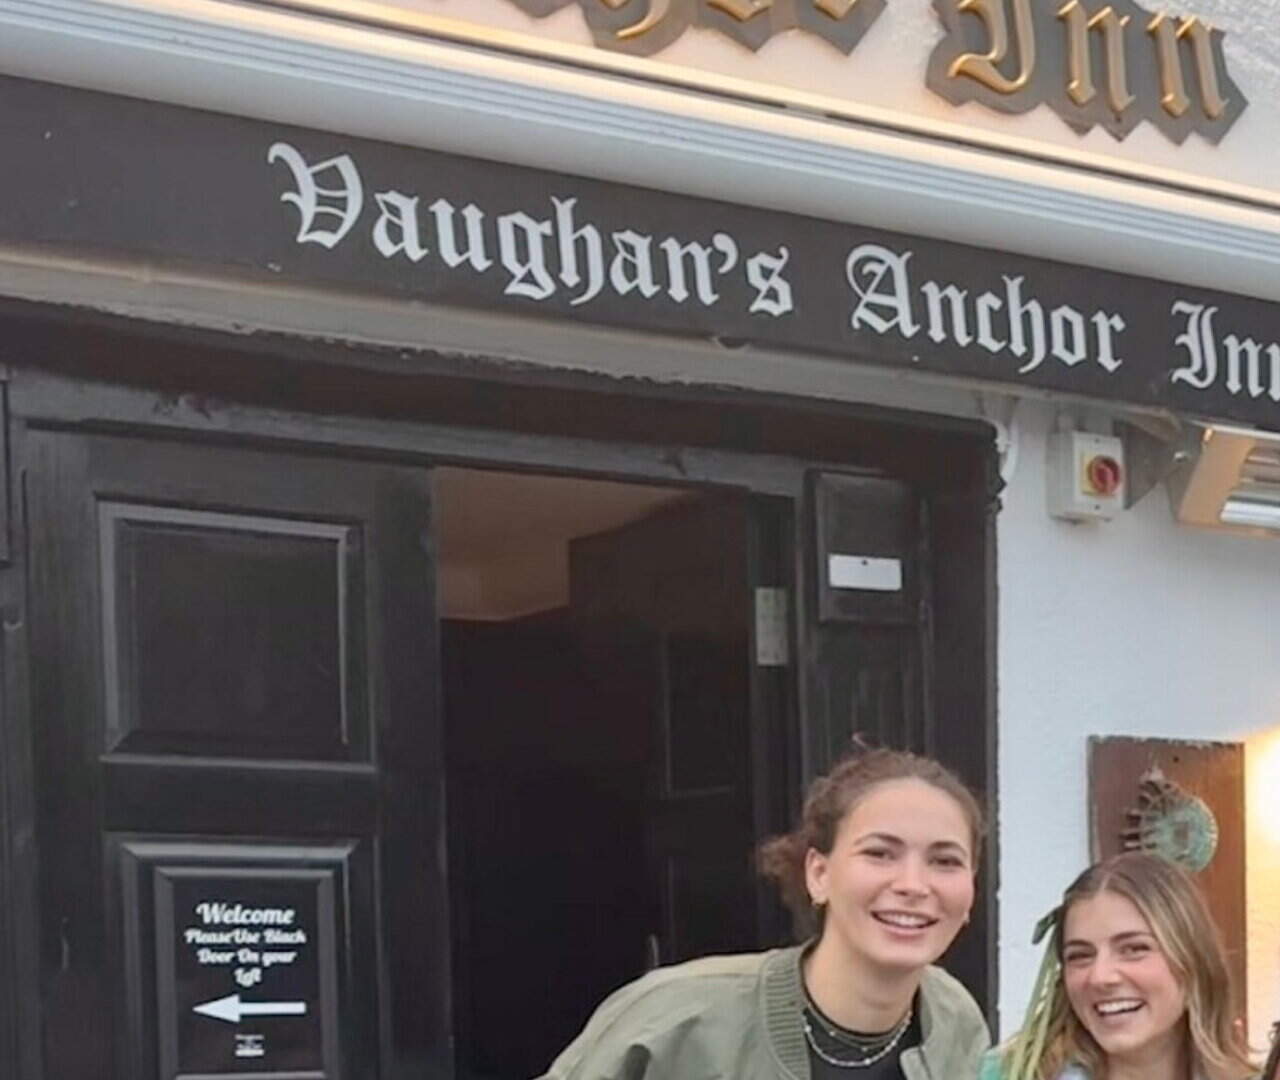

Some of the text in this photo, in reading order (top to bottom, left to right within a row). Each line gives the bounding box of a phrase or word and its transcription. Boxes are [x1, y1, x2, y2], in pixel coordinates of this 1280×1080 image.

[268, 142, 794, 317] Vaughan's
[846, 244, 1127, 374] Anchor
[196, 902, 296, 925] Welcome
[184, 927, 307, 944] Please Use Black
[197, 948, 297, 967] Door On your
[234, 967, 262, 987] Left
